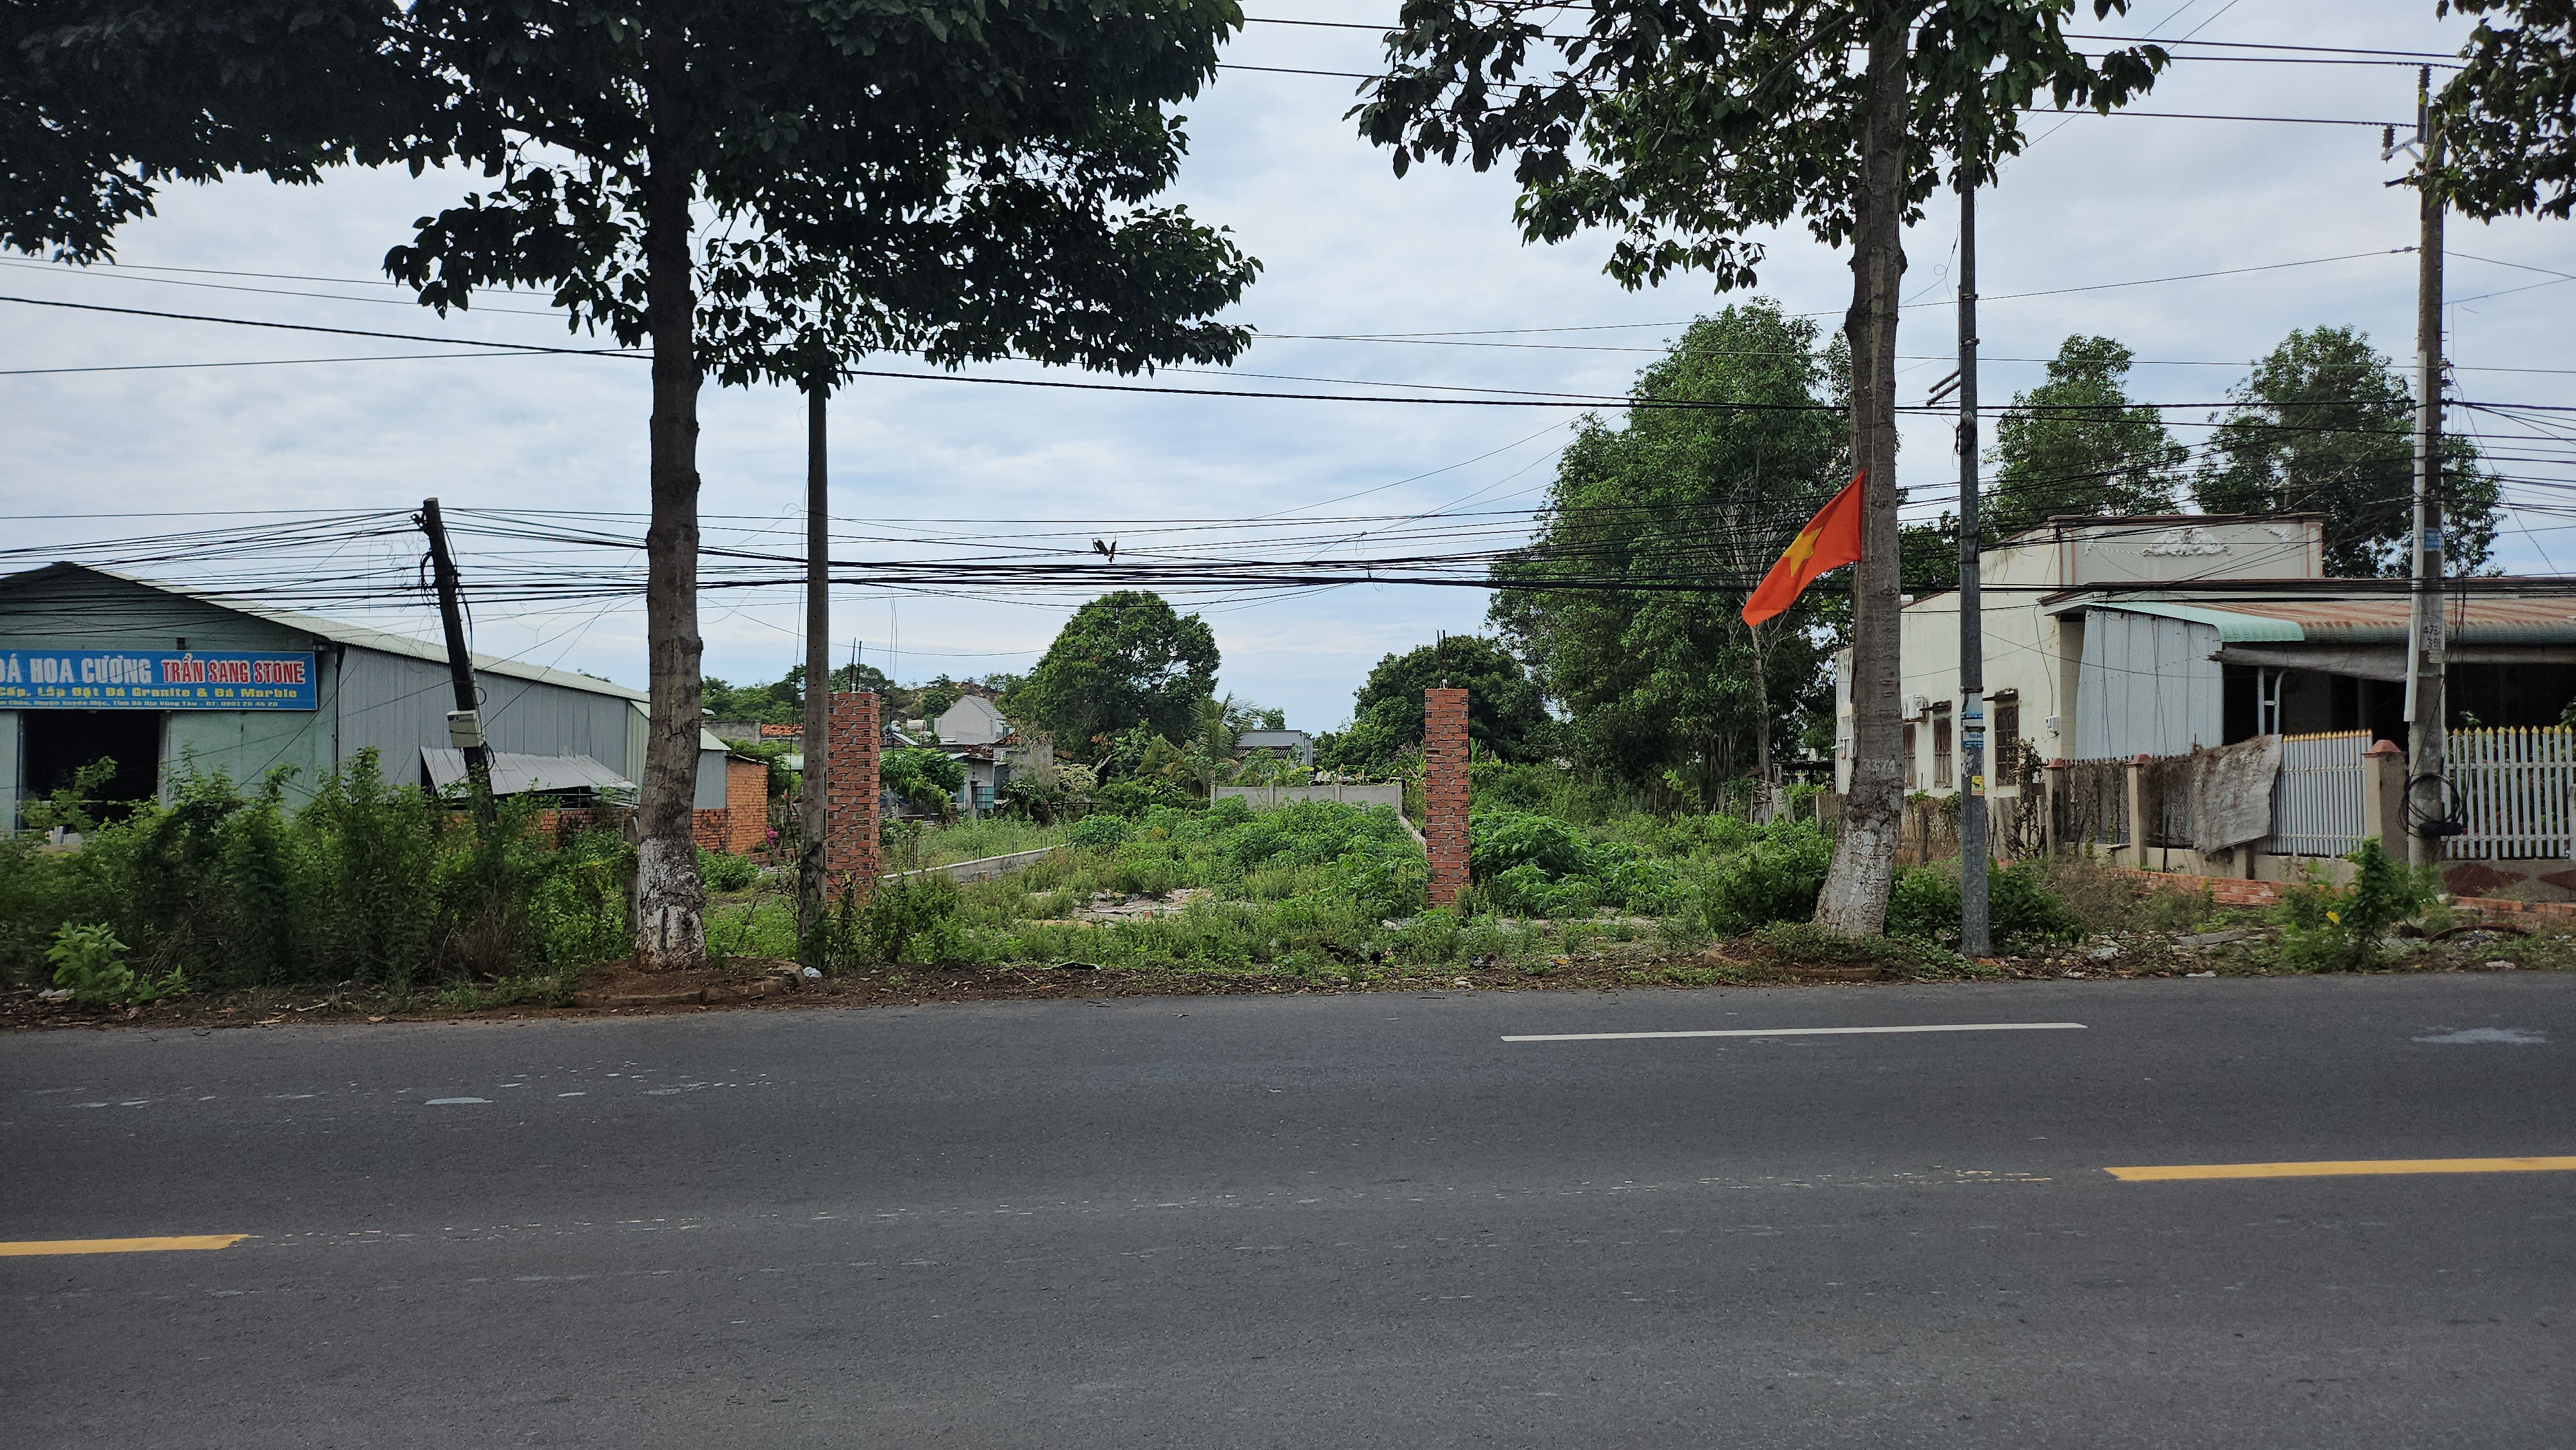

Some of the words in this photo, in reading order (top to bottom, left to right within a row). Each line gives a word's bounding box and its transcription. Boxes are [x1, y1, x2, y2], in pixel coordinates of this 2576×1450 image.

[30, 657, 74, 683] HOA
[81, 655, 151, 684] CƯƠNG
[207, 659, 251, 684] SANG
[253, 660, 306, 684] STONE
[106, 686, 125, 697] Đá
[131, 687, 191, 697] Granite
[196, 688, 208, 697] &
[214, 688, 234, 697] Đá
[240, 688, 297, 698] Marble
